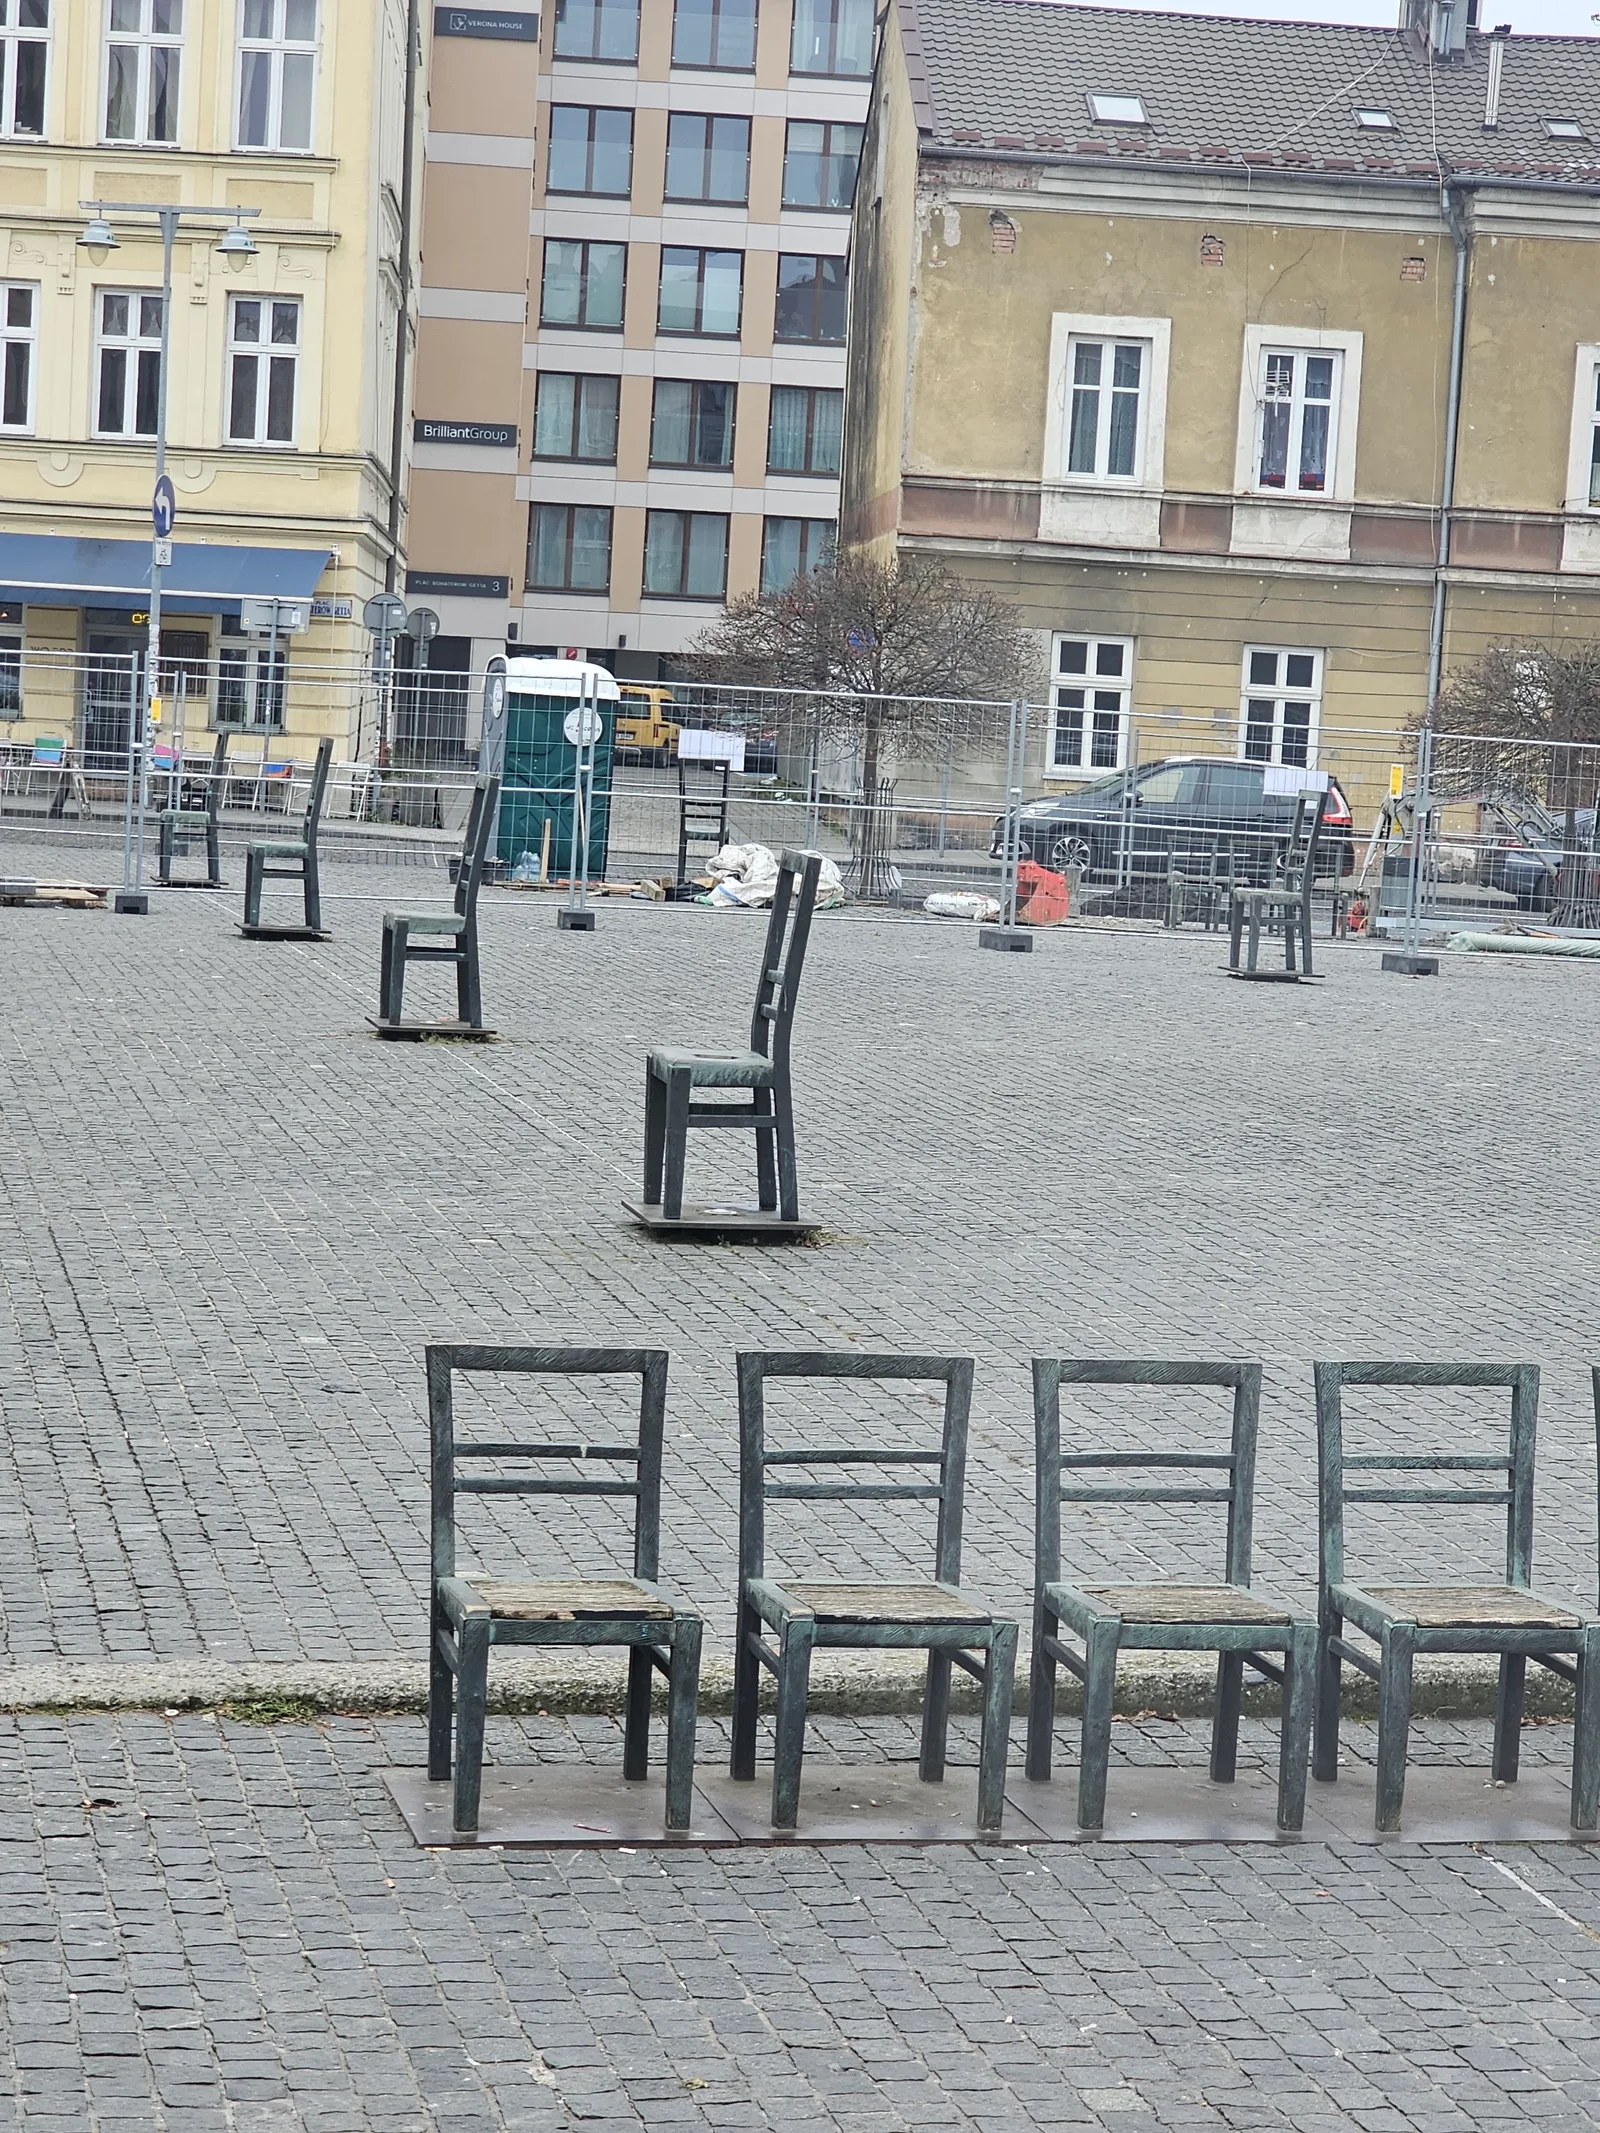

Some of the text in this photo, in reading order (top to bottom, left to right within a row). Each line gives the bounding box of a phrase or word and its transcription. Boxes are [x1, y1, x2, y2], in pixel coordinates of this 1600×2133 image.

[467, 20, 523, 30] VERONA HOUSE
[424, 425, 508, 442] BrilliantGroup
[492, 581, 500, 592] 3
